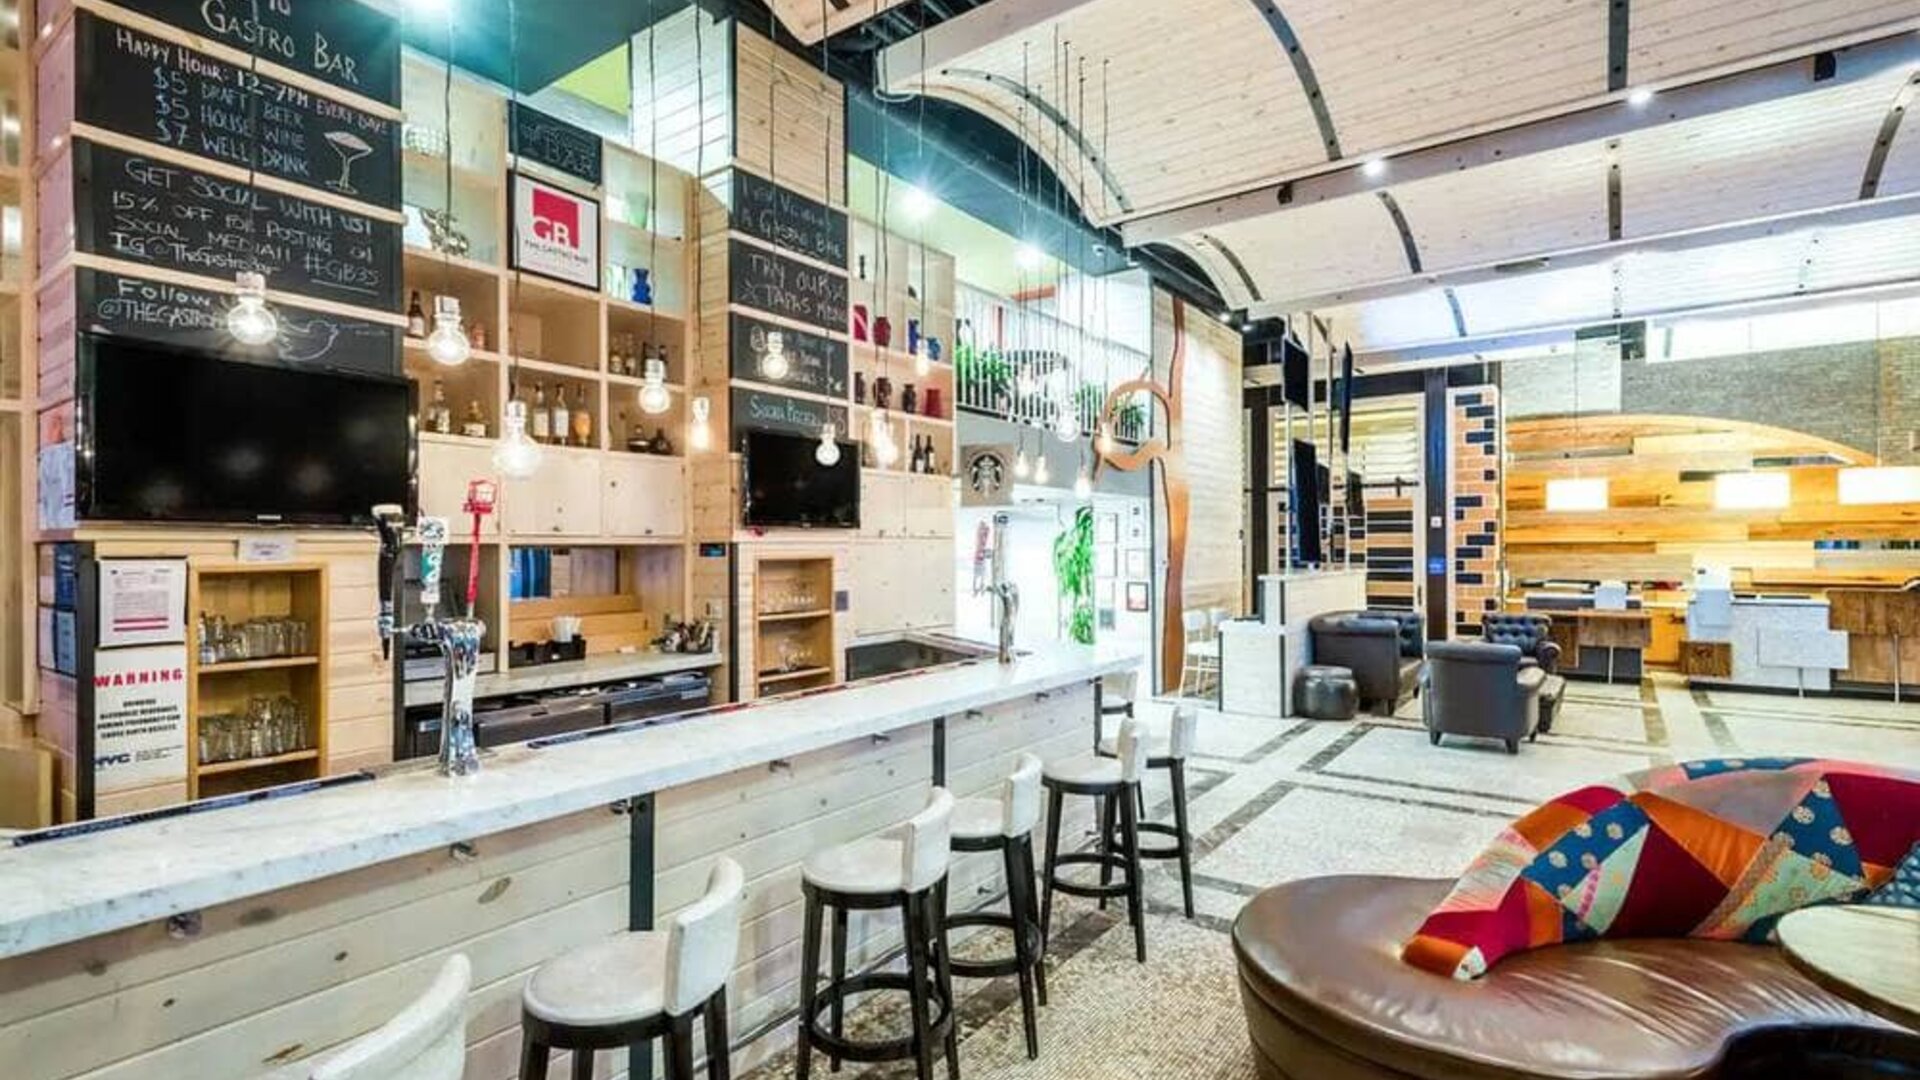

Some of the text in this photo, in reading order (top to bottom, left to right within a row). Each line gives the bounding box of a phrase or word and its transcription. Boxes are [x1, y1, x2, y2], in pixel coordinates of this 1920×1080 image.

[116, 27, 170, 64] HAPPY
[200, 0, 359, 85] GASTRO BAR
[153, 69, 304, 127] $5 DRAFT BEER
[154, 94, 306, 151] $5 HOUSE WINE
[155, 121, 310, 177] $7 WELL DRINK
[125, 158, 180, 189] GET
[191, 175, 270, 212] SOCIAL
[279, 194, 333, 228] WITH
[174, 204, 214, 222] OFF
[266, 220, 333, 255] POSTING
[531, 215, 571, 247] GB
[117, 278, 211, 306] Follow
[796, 270, 831, 298] OUR
[91, 668, 183, 687] WARNING
